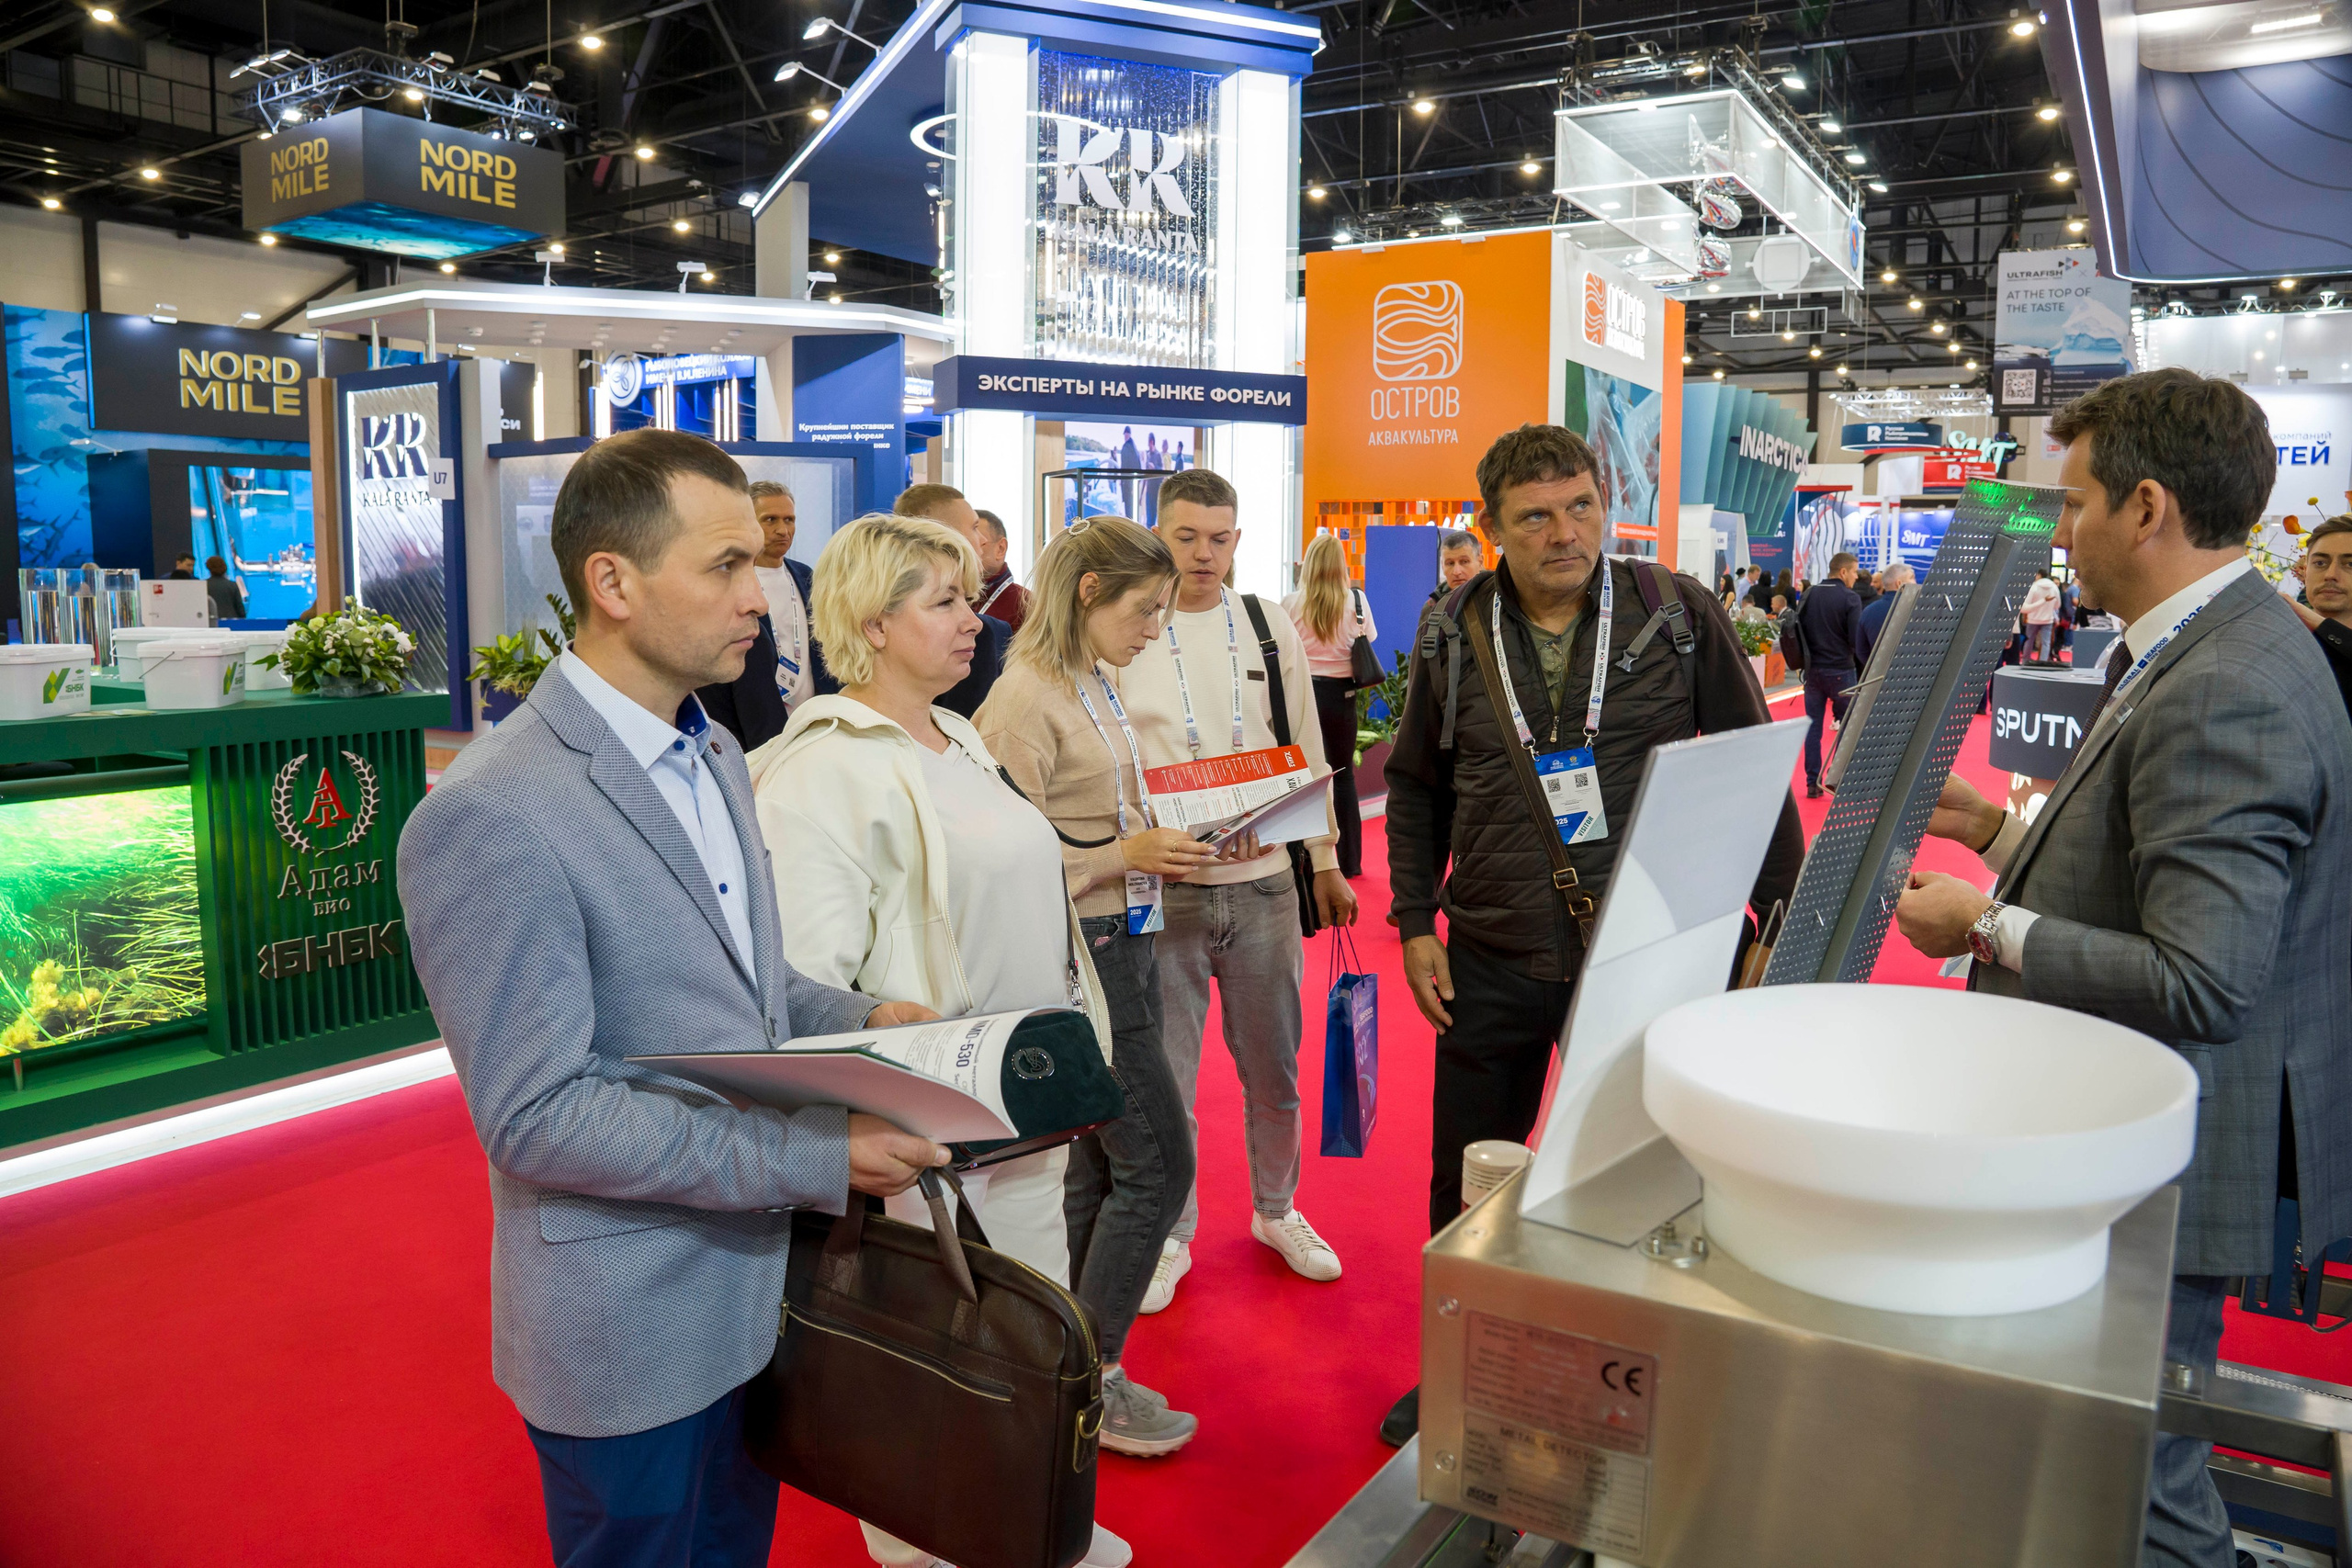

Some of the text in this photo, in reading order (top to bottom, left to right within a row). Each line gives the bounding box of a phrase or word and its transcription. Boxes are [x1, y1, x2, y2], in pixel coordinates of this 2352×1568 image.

[271, 137, 329, 175] NORD
[420, 139, 516, 180] NORD
[271, 164, 329, 203] MILE
[421, 165, 516, 209] MILE
[1055, 220, 1199, 253] KALA RANTA
[2007, 269, 2063, 279] ULTRAFISH
[2007, 287, 2091, 300] AT THE TOP OF
[2007, 302, 2064, 313] THE TASTE
[179, 348, 301, 385] NORD
[180, 378, 301, 417] MILE
[978, 375, 1291, 407] ЭКСПЕРТЫ НА РЫНКЕ ФОРЕЛИ
[1370, 386, 1460, 421] ОСТРОВ
[812, 432, 884, 442] радужной форели
[1368, 429, 1459, 446] АКВАКУЛЬТУРА
[2273, 431, 2332, 441] компаний
[1740, 423, 1810, 478] INARCTICA
[1947, 430, 2017, 473] SMT
[434, 472, 447, 484] U7
[363, 490, 433, 507] KALA RANTA
[1901, 529, 1929, 547] SMT
[2143, 637, 2169, 660] SEAFOOD
[1114, 700, 1124, 716] SEAFOOD
[1283, 751, 1295, 768] XAVIS
[1555, 817, 1568, 826] 025
[1577, 816, 1594, 837] VISITOR
[277, 859, 383, 901] Адам
[313, 897, 351, 917] БИО
[1146, 908, 1157, 928] VISITOR
[272, 919, 402, 979] БНБК
[956, 1020, 990, 1067] NMD-530
